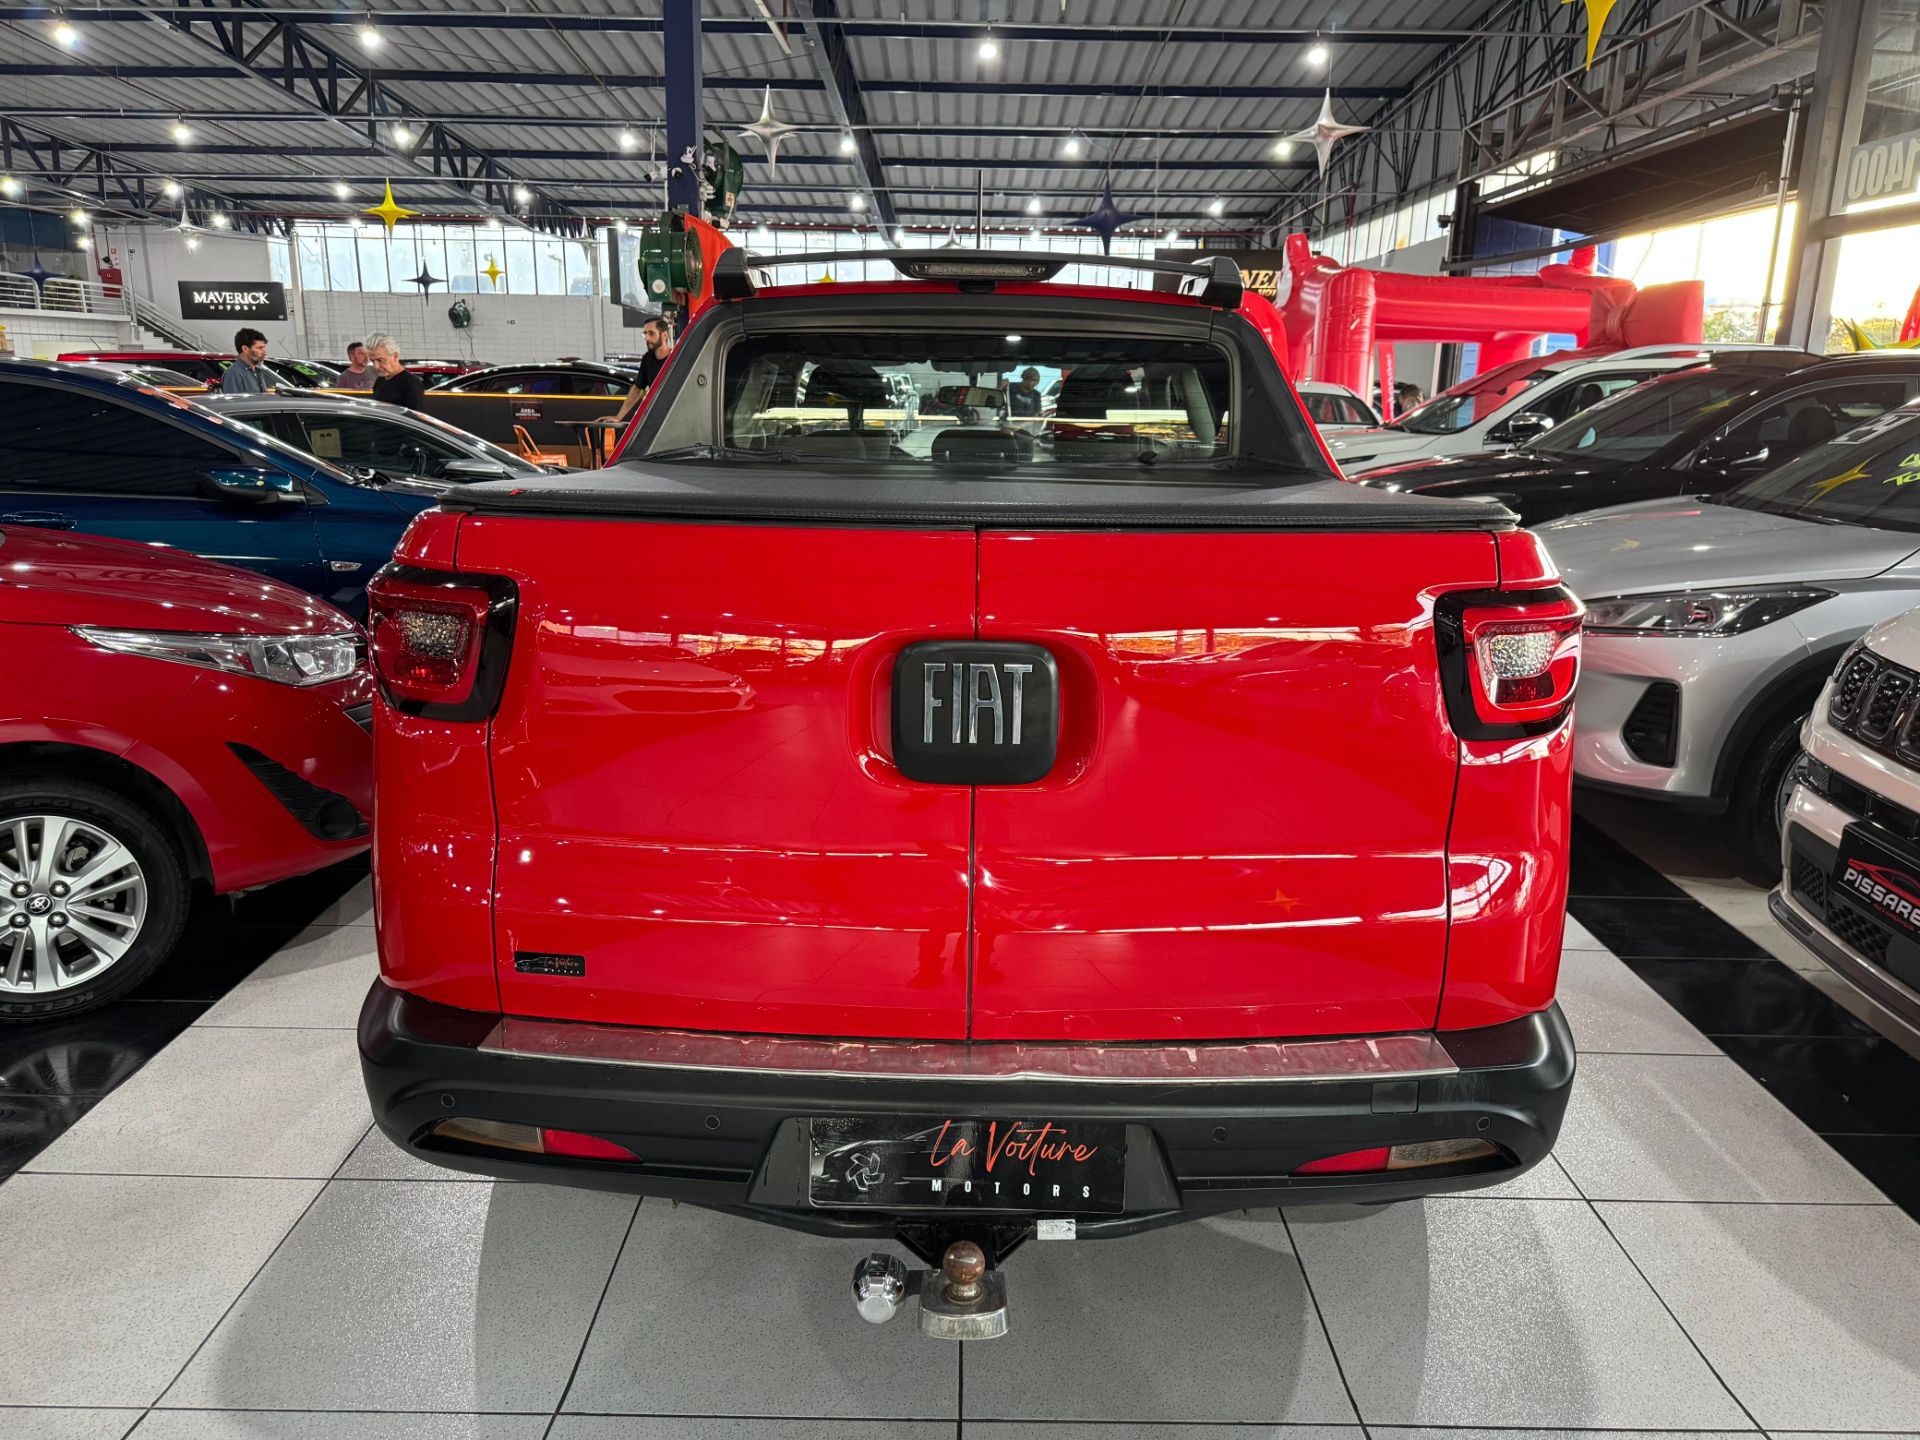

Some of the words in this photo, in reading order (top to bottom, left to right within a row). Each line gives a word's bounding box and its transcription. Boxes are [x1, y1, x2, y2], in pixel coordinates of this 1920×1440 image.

[193, 291, 270, 304] MAVERICK
[923, 662, 1034, 745] FIAT
[930, 1119, 975, 1167] La
[986, 1121, 1098, 1176] Voiture
[931, 1179, 1090, 1198] MOTORS
